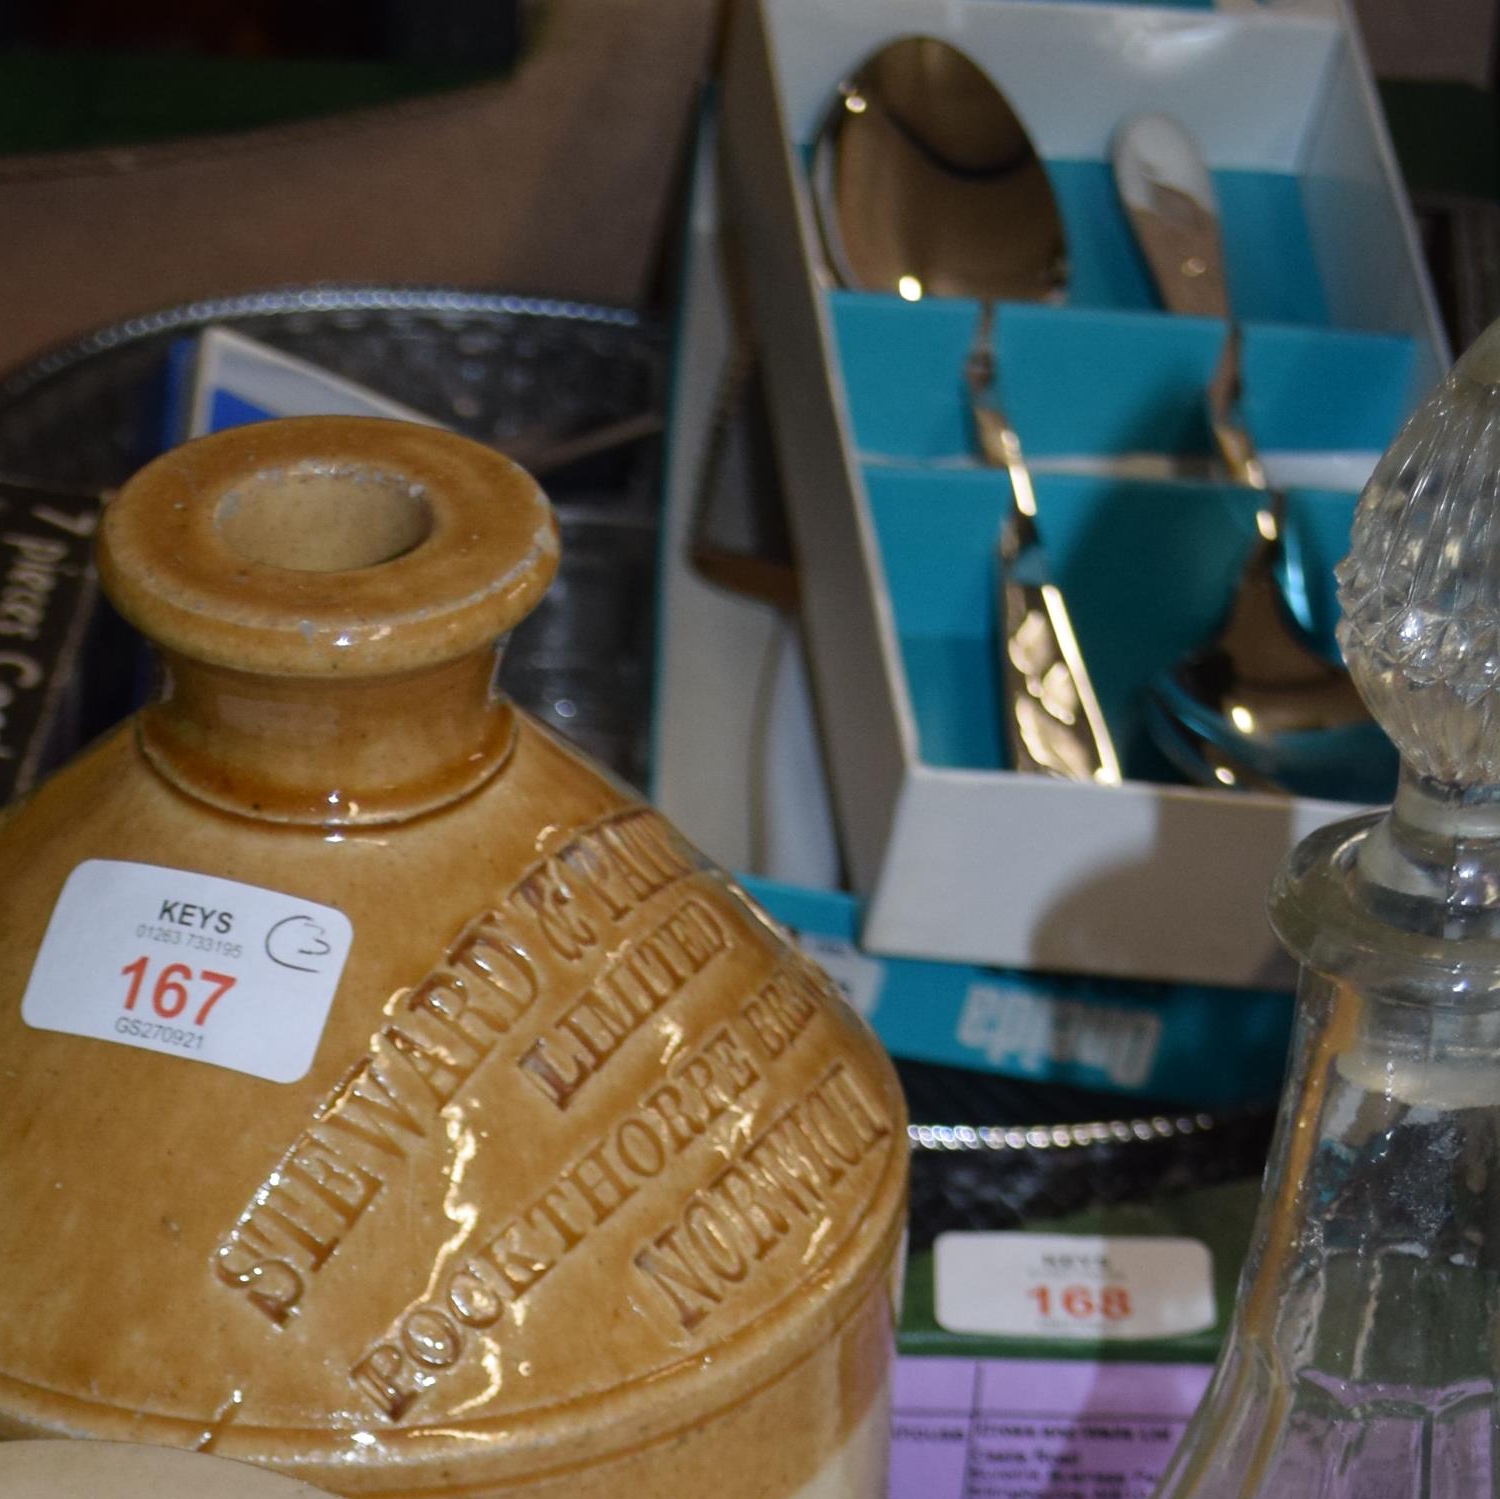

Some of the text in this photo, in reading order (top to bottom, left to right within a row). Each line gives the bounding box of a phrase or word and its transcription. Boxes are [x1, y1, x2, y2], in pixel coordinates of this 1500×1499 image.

[33, 504, 94, 537] 7
[135, 924, 244, 960] 01263 733195
[159, 899, 235, 935] KEYS
[119, 955, 237, 1027] 167
[518, 900, 734, 1112] LIMITED
[114, 1016, 206, 1051] GS270921
[215, 908, 546, 1328] STEWARD
[635, 1060, 894, 1331] NORWICH
[348, 1026, 761, 1422] POCKTHORPE
[1029, 1286, 1134, 1321] 168
